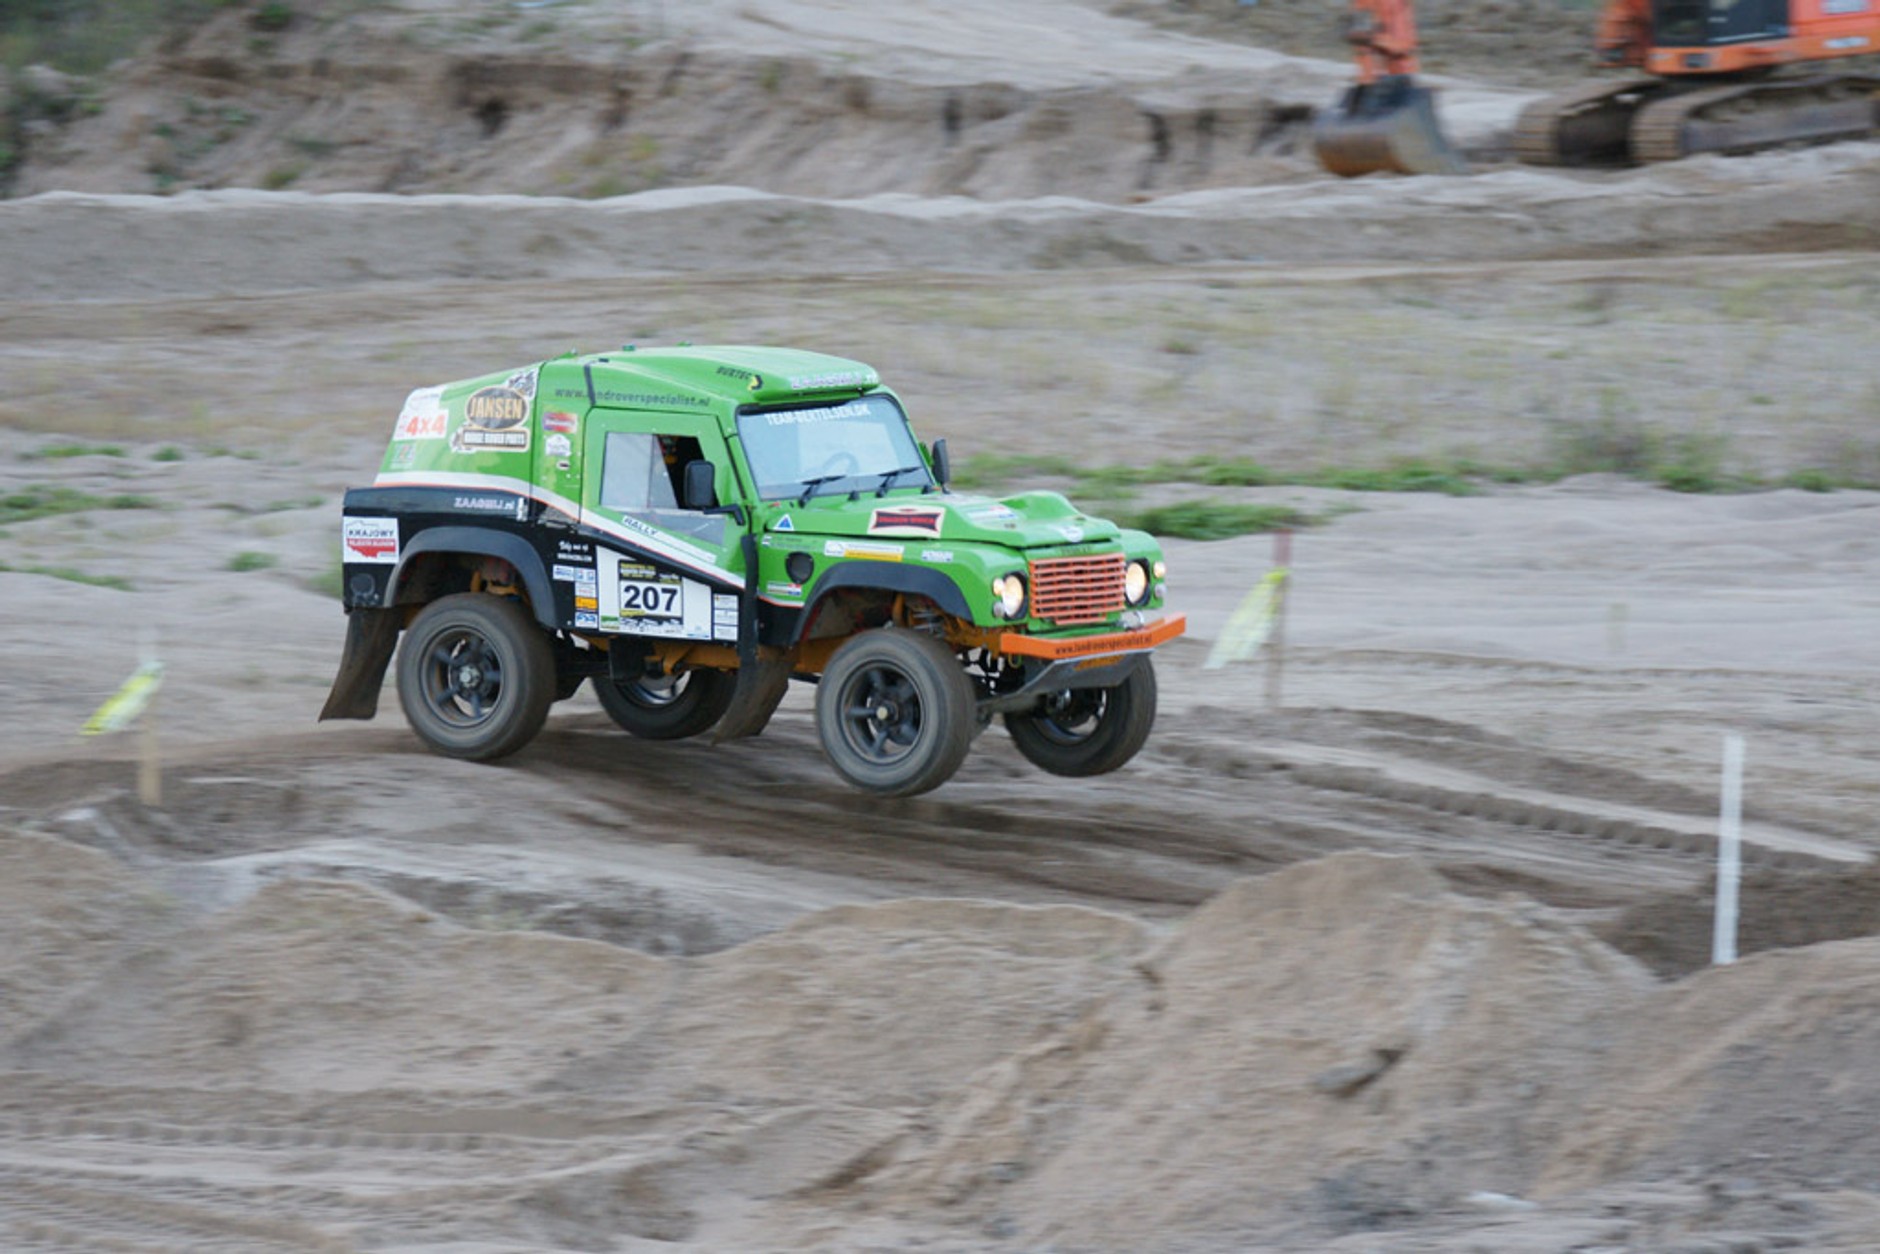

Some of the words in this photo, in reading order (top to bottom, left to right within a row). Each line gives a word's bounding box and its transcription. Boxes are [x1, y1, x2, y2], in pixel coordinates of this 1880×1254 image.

[555, 388, 710, 407] www.ndroverspecialist.nl
[470, 397, 523, 419] JANSEN
[624, 517, 659, 536] RALLY
[624, 585, 678, 611] 207
